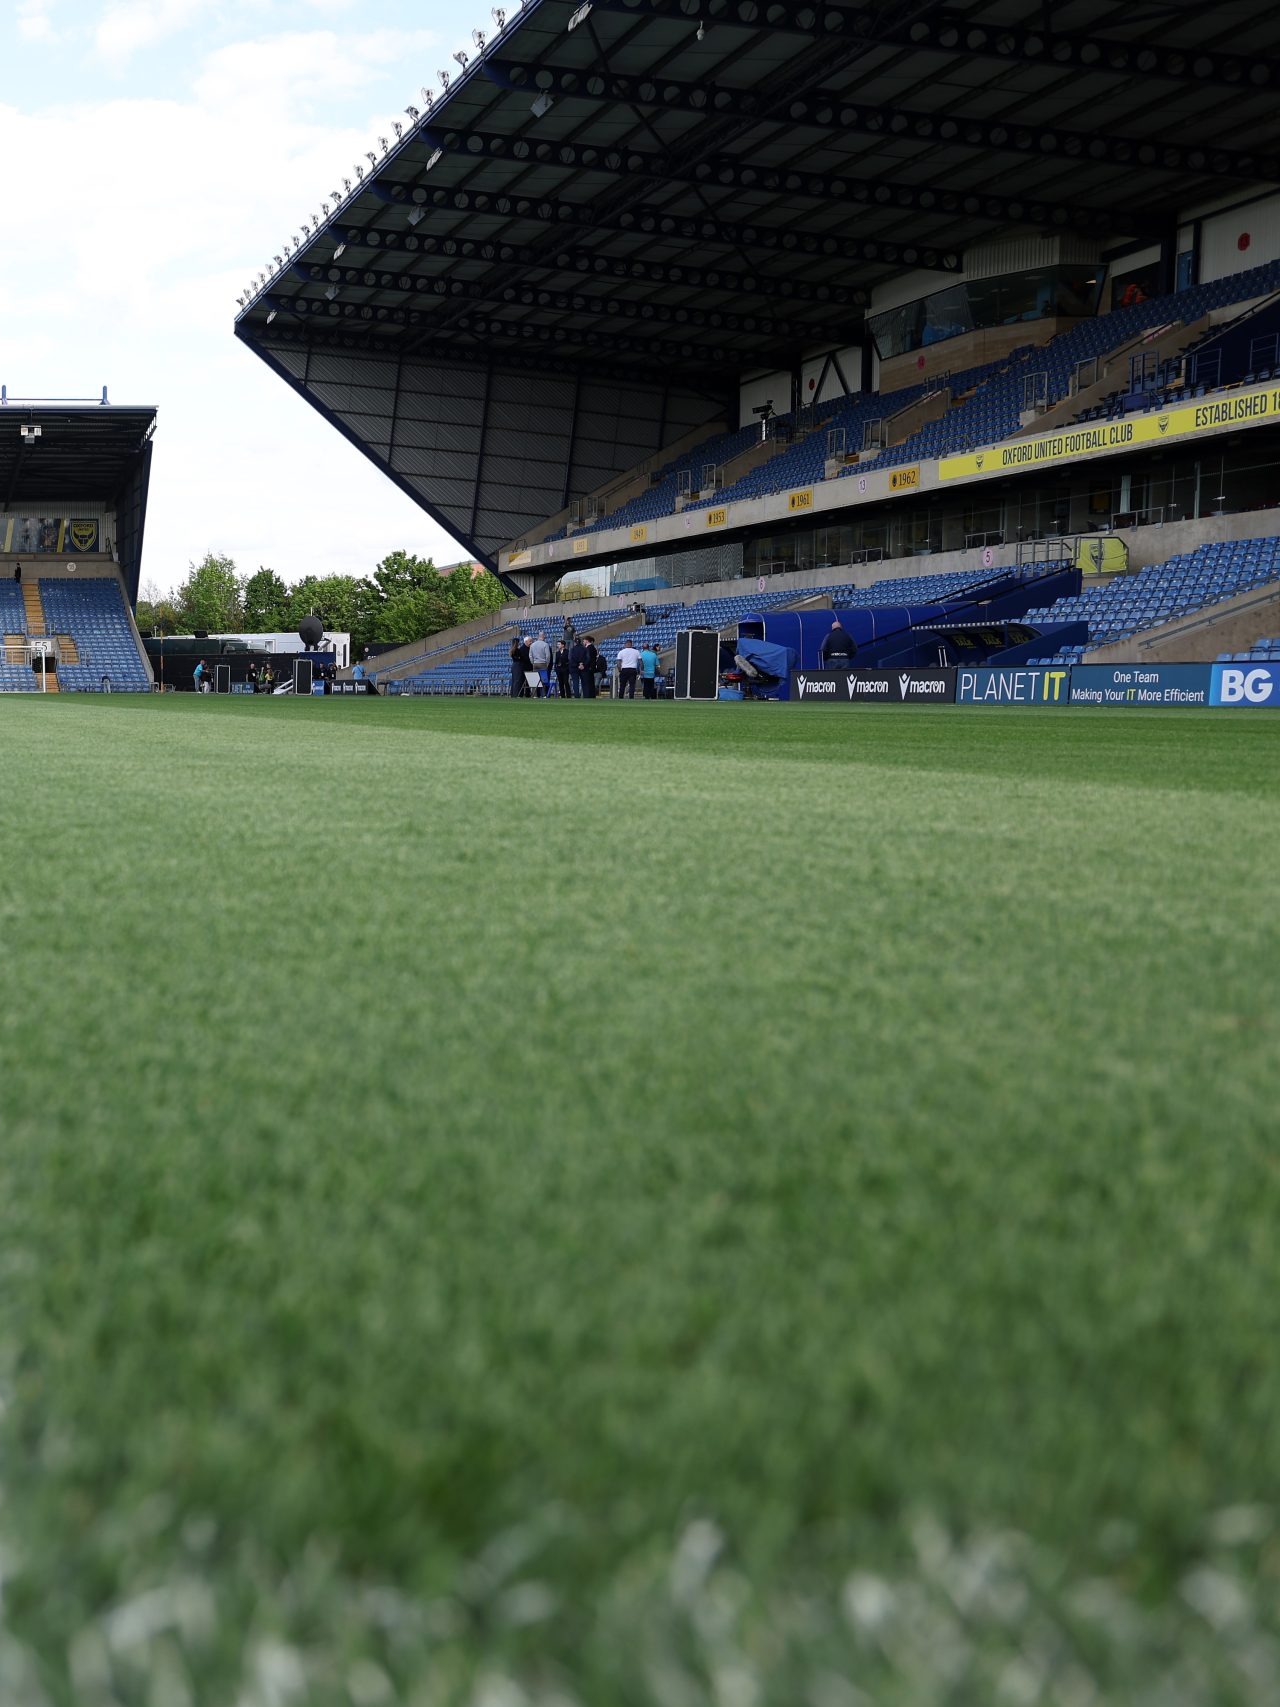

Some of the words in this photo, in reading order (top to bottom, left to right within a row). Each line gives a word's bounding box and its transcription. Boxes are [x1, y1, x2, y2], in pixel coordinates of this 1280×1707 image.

[1195, 394, 1268, 427] ESTABLISHED
[1272, 391, 1280, 411] 1
[1002, 444, 1032, 466] OXFORD
[1034, 439, 1062, 459] UNITED
[1065, 429, 1107, 453] FOOTBALL
[1109, 423, 1133, 445] CLUB
[898, 470, 916, 486] 1962
[796, 494, 810, 507] 1961
[1113, 671, 1132, 683] One
[1133, 671, 1159, 683] Team
[806, 681, 836, 693] macron
[856, 681, 889, 693] macron
[909, 680, 946, 693] macron
[960, 672, 1040, 700] PLANET
[1042, 671, 1066, 701] IT
[1220, 668, 1273, 703] BG
[1072, 689, 1102, 702] Making
[1104, 689, 1125, 700] Your
[1126, 689, 1136, 700] IT
[1138, 689, 1162, 701] More
[1164, 689, 1204, 702] Efficient
